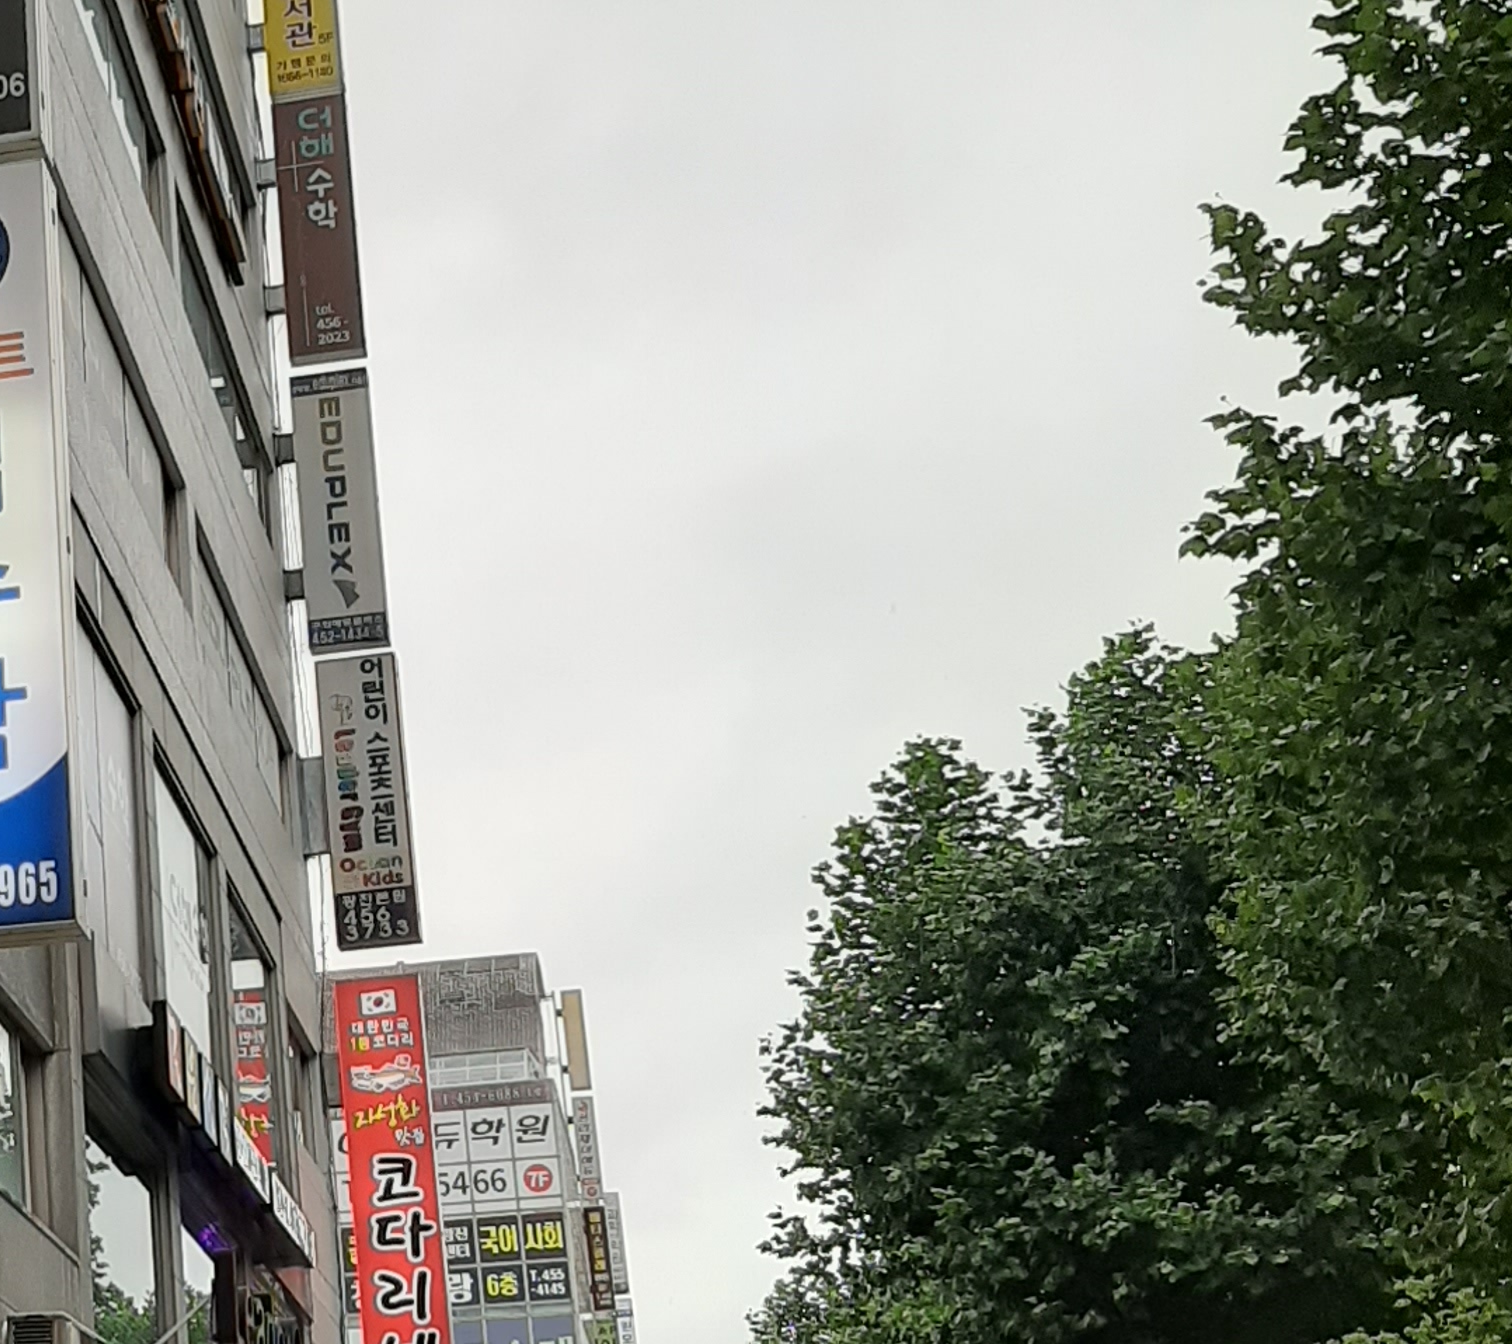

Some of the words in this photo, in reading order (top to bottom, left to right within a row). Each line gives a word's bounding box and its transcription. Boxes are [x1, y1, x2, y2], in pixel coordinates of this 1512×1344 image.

[298, 106, 336, 157] 더해
[306, 167, 338, 229] 수학
[318, 396, 356, 575] EDUPLEX
[359, 657, 388, 726] 어린이
[366, 730, 399, 848] 스포츠센터
[363, 869, 405, 888] Kids
[343, 905, 391, 927] 456
[479, 1224, 519, 1255] 국어
[525, 1220, 565, 1250] 사회
[487, 1271, 520, 1297] 6층
